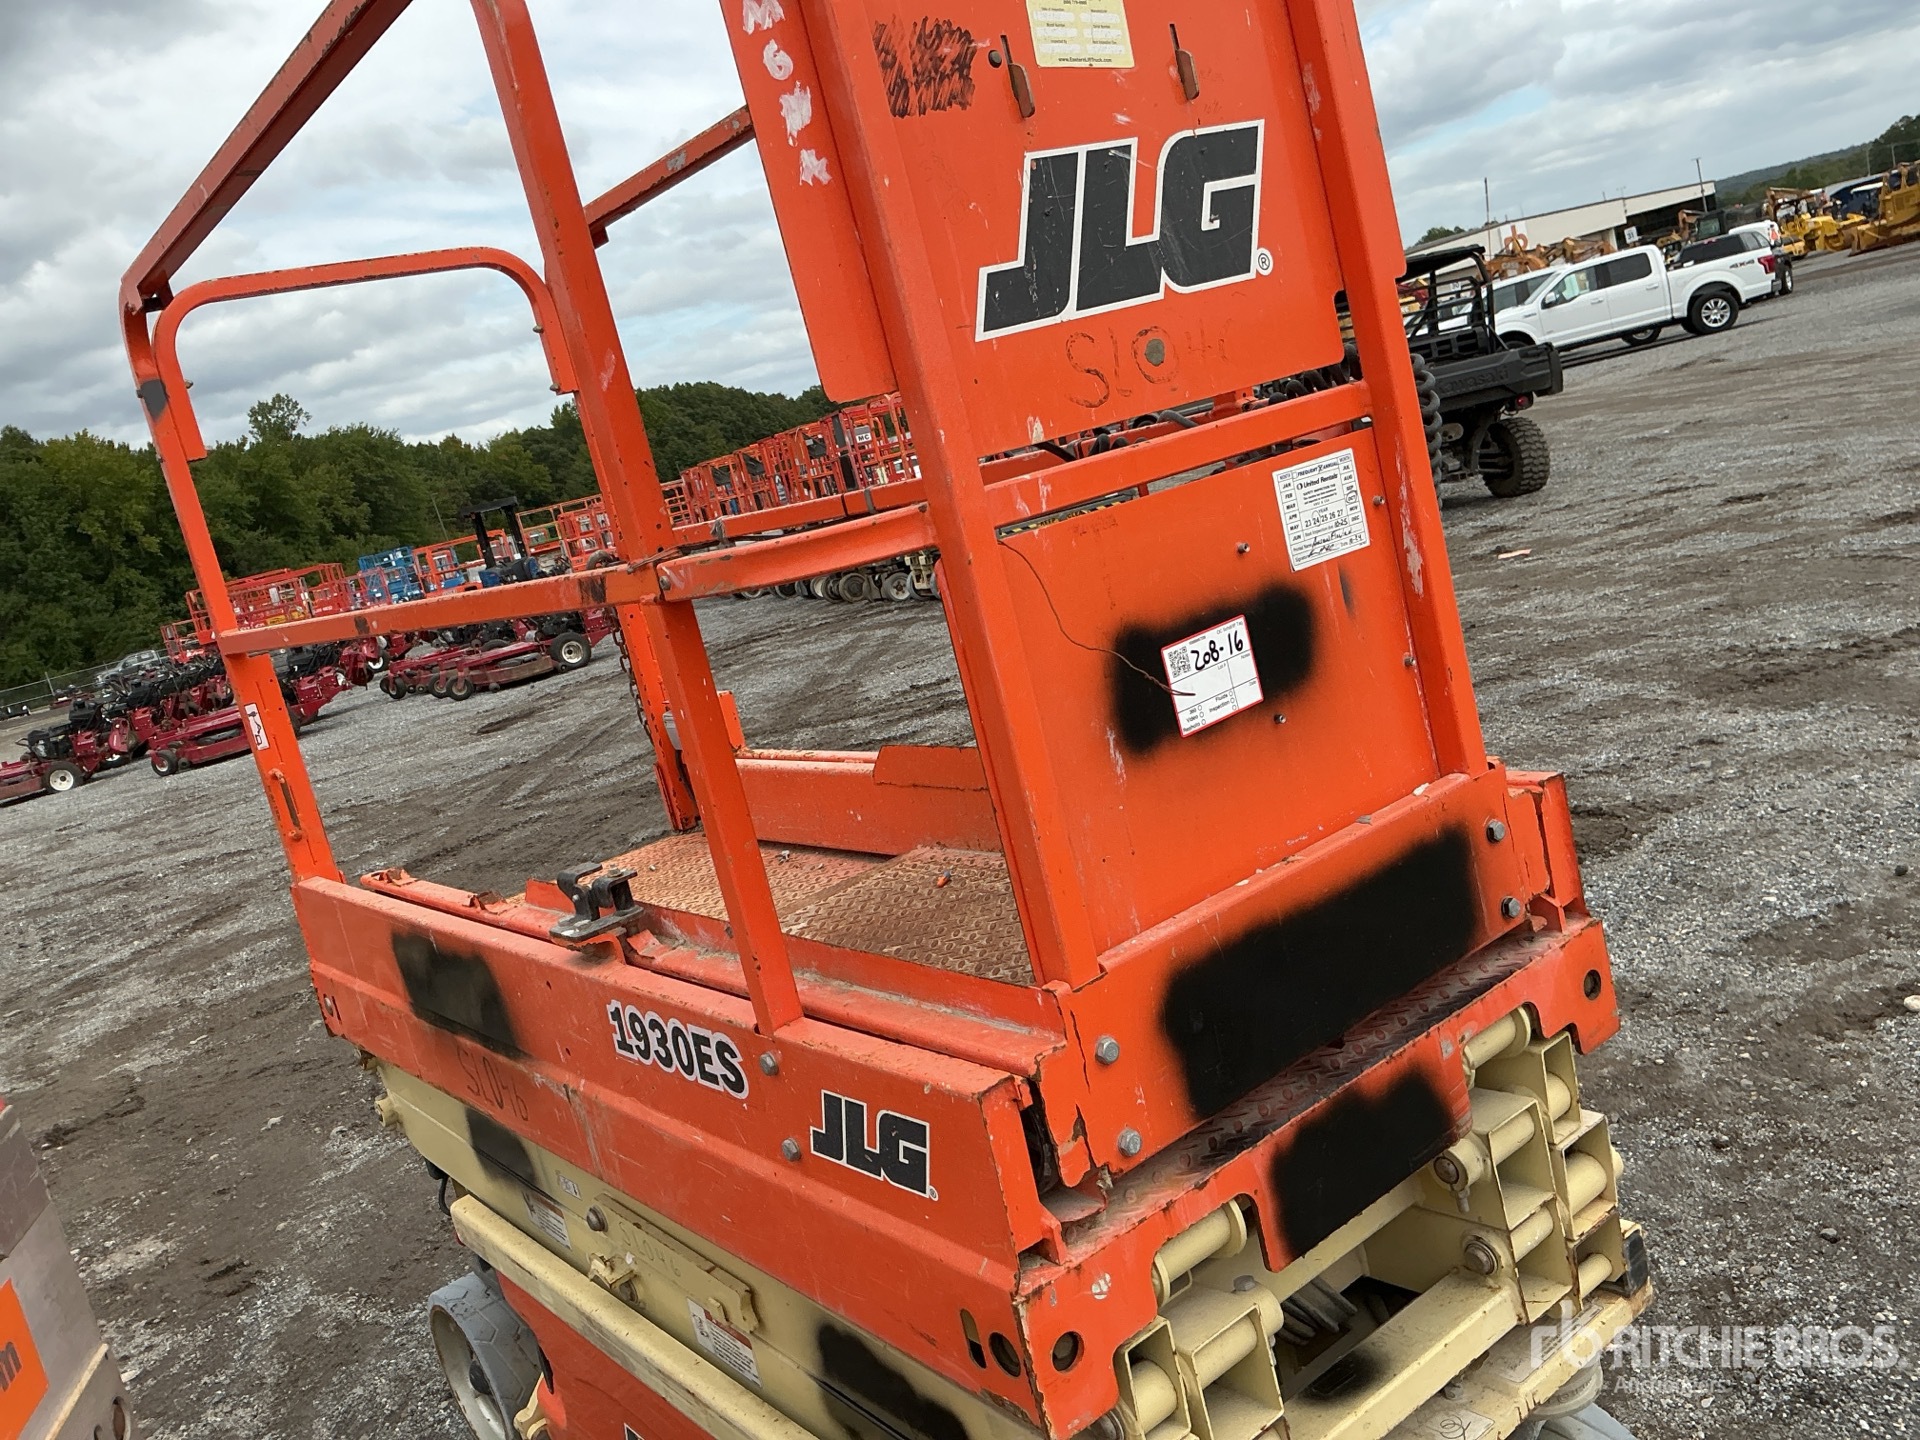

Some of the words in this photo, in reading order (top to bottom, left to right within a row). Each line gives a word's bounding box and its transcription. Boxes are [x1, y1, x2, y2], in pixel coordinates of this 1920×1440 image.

[977, 121, 1262, 340] JLG
[1304, 479, 1319, 488] United
[1337, 509, 1344, 517] 27
[1190, 630, 1243, 670] 208-16
[1215, 694, 1228, 702] Fluids
[1209, 700, 1230, 713] Inspection
[1186, 715, 1198, 723] Video
[608, 1003, 747, 1096] 1930ES
[812, 1090, 929, 1198] JLG
